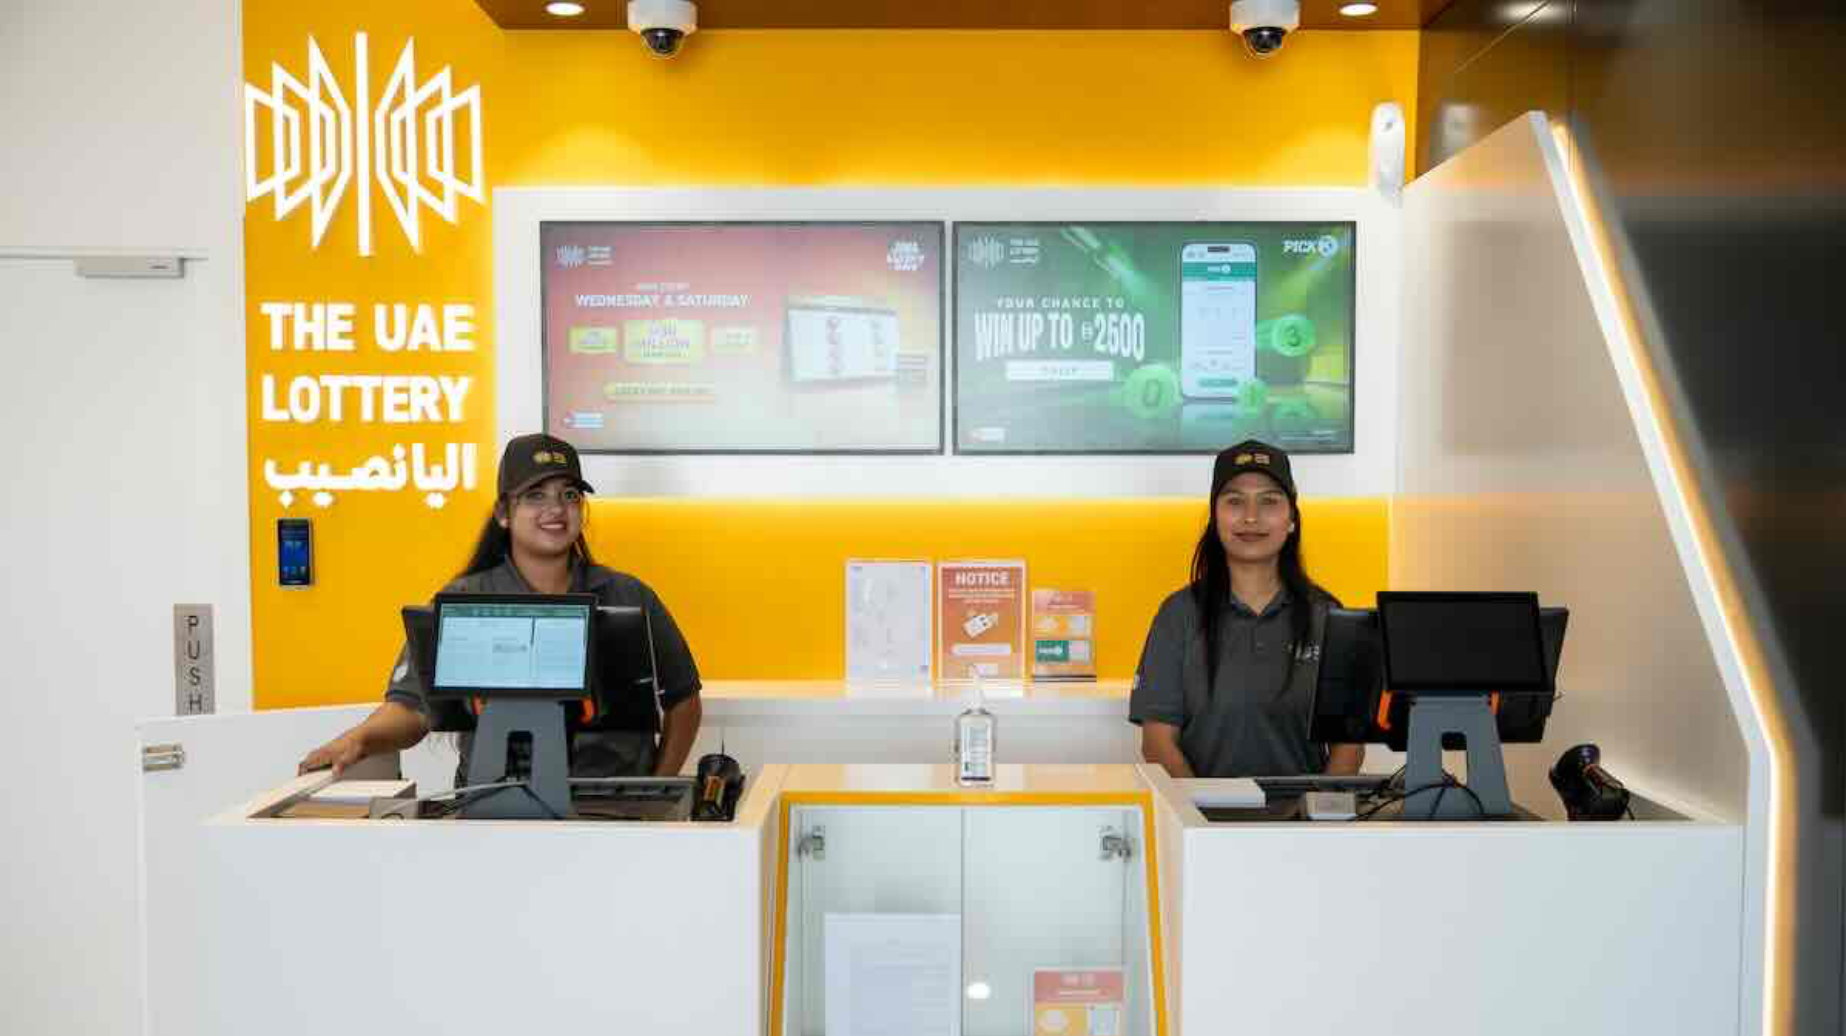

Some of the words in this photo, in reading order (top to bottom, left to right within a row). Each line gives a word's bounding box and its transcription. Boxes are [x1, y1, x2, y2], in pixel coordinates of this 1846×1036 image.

[574, 294, 661, 309] WEDNESDAY
[679, 294, 751, 309] SATURDAY
[997, 297, 1035, 309] YOUR
[1041, 297, 1101, 309] CHANCE
[1107, 297, 1125, 309] TO
[259, 302, 355, 351] THE
[373, 302, 476, 351] UAE
[974, 312, 1014, 361] WIN
[1018, 312, 1044, 351] UP
[1047, 312, 1073, 349] TO
[1286, 325, 1301, 347] 3
[261, 374, 472, 422] LOTTERY
[263, 443, 478, 508] اليانصيب
[955, 571, 1010, 586] NOTICE
[188, 615, 202, 715] PUSH
